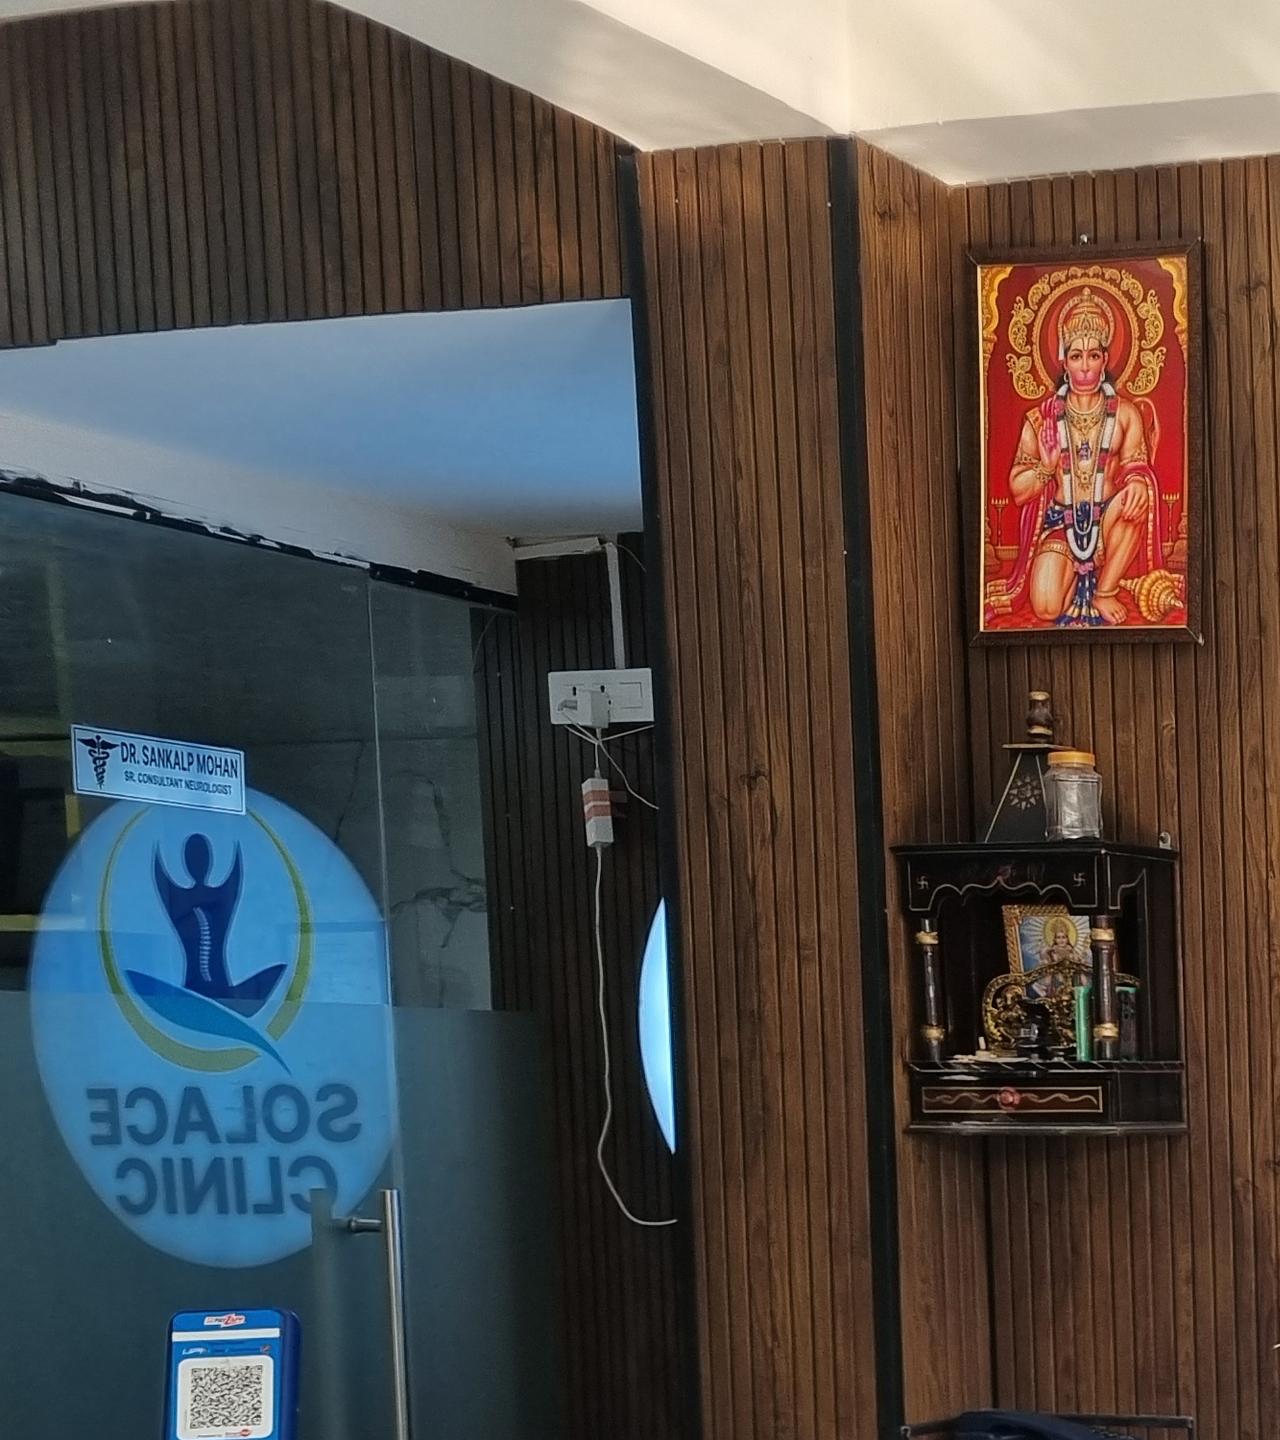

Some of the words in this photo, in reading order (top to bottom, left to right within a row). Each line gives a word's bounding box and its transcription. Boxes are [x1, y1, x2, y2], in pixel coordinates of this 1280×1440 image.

[120, 741, 140, 764] DR.
[142, 745, 195, 772] SANKALP
[196, 753, 239, 779] MOHAN
[137, 773, 183, 789] CONSULTANT
[184, 780, 232, 796] NEUROLOGIST
